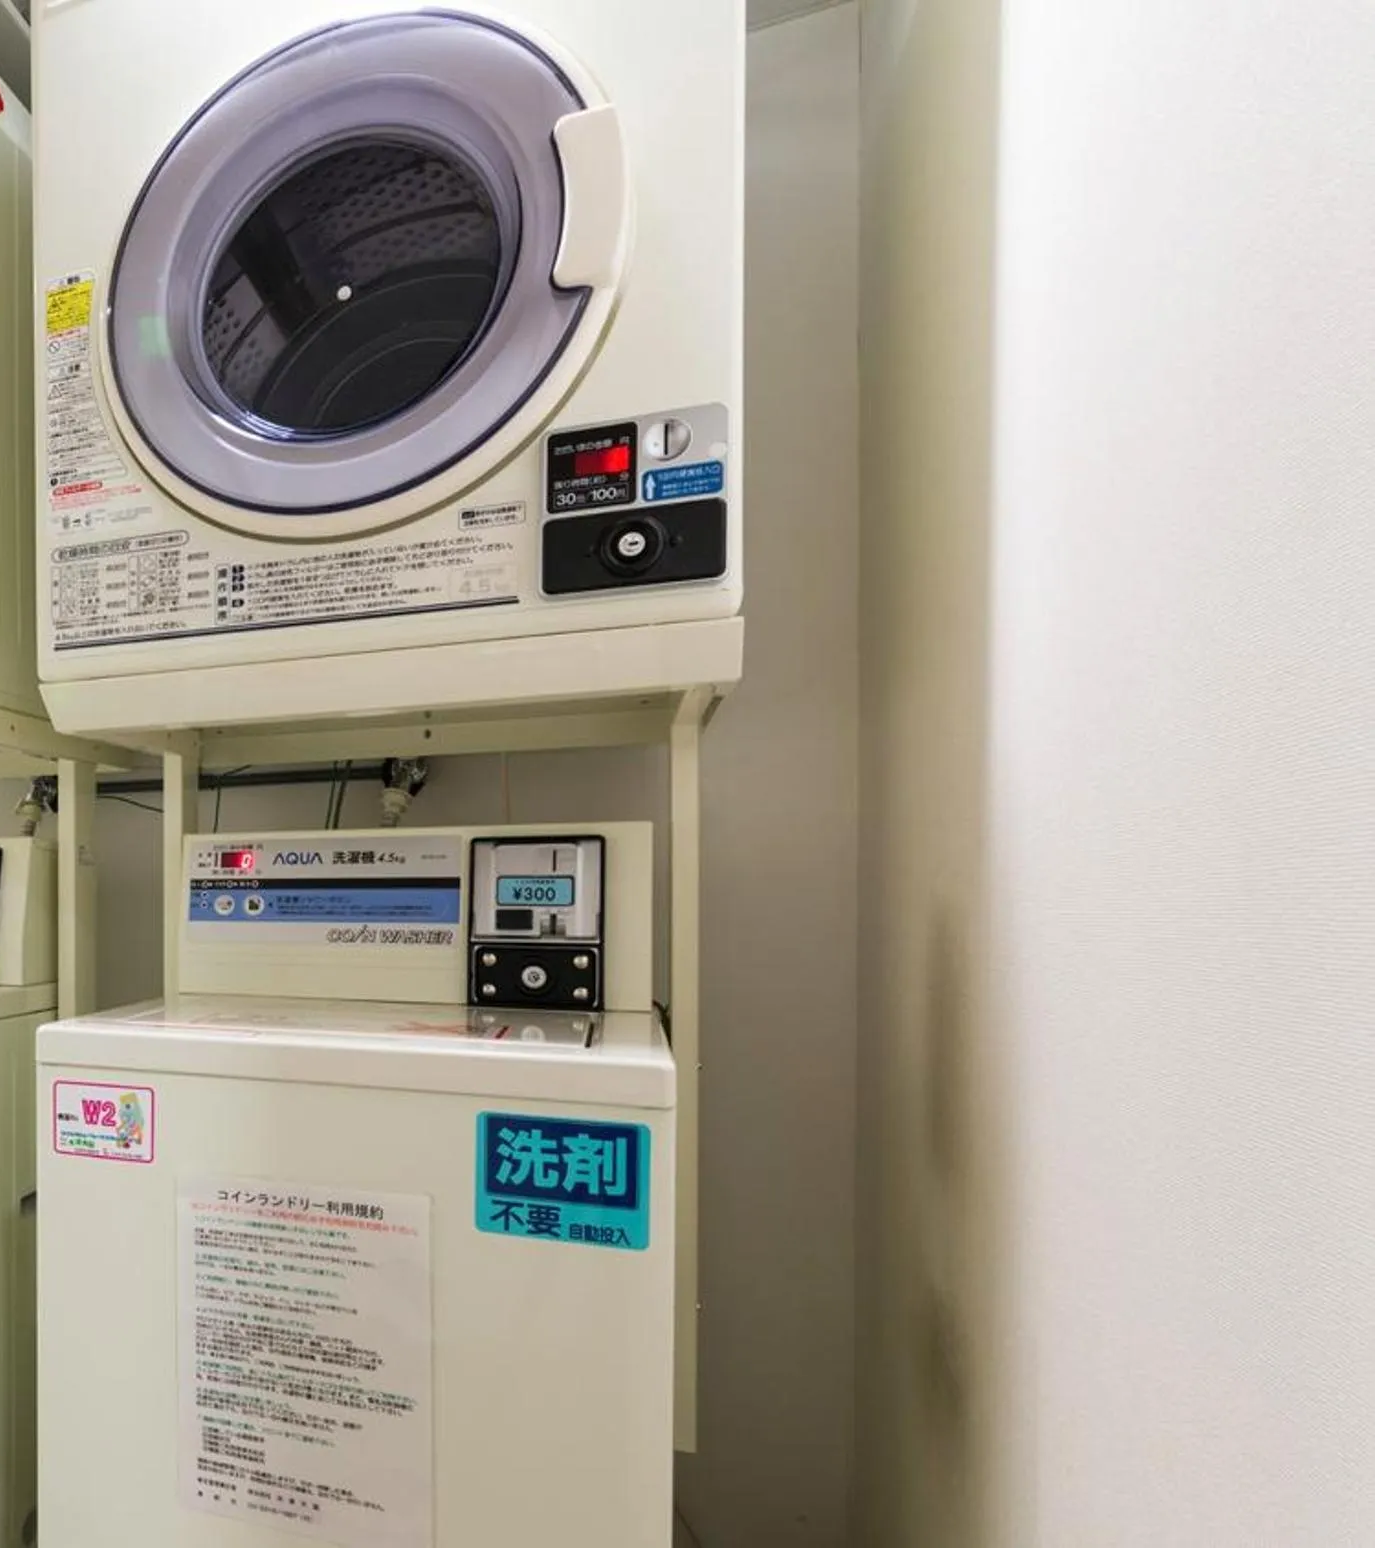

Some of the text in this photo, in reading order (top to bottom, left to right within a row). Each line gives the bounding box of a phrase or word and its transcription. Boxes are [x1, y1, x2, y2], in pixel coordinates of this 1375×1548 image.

[273, 852, 323, 865] AQUA
[332, 851, 374, 865] 洗濯機
[512, 886, 556, 901] ¥300
[81, 1098, 116, 1127] W2
[496, 1128, 627, 1196] 洗剤
[217, 1189, 384, 1220] コインランドリー利用規約
[490, 1200, 631, 1246] 不要 自動投入
